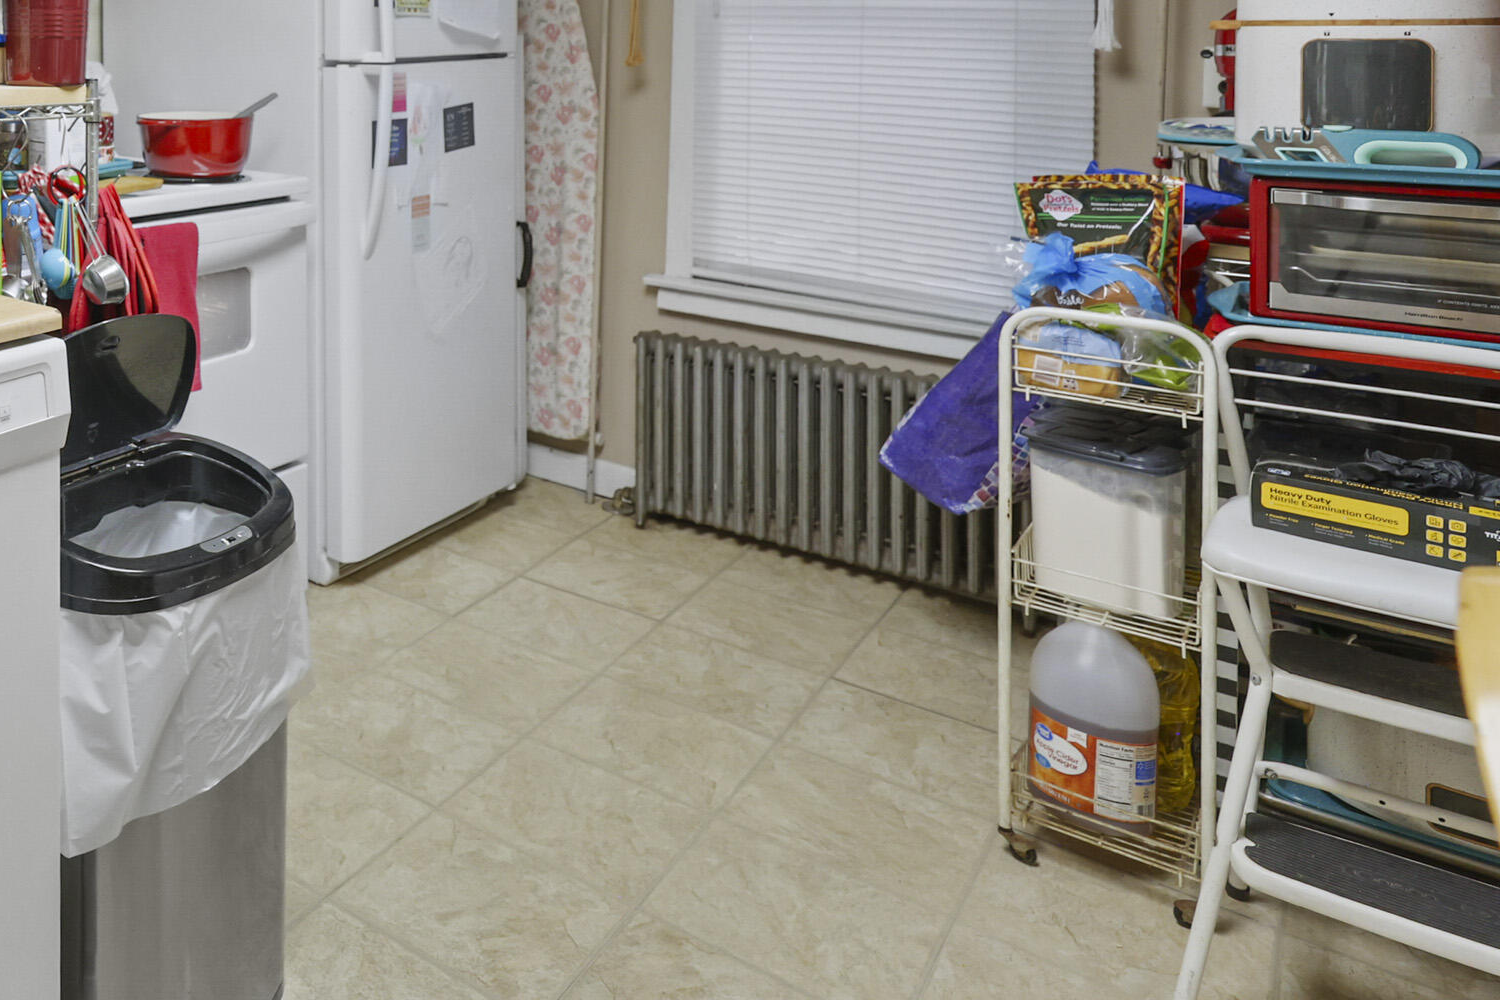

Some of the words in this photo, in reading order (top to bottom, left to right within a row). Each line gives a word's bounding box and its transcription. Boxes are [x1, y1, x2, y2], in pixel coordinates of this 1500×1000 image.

[1044, 193, 1073, 204] Dot's
[1042, 204, 1080, 214] Pretzels
[1269, 487, 1302, 500] Heavy
[1305, 494, 1332, 505] Duty
[1269, 494, 1299, 506] Nitrile
[1301, 500, 1362, 518] Examination
[1364, 512, 1400, 526] Gloves
